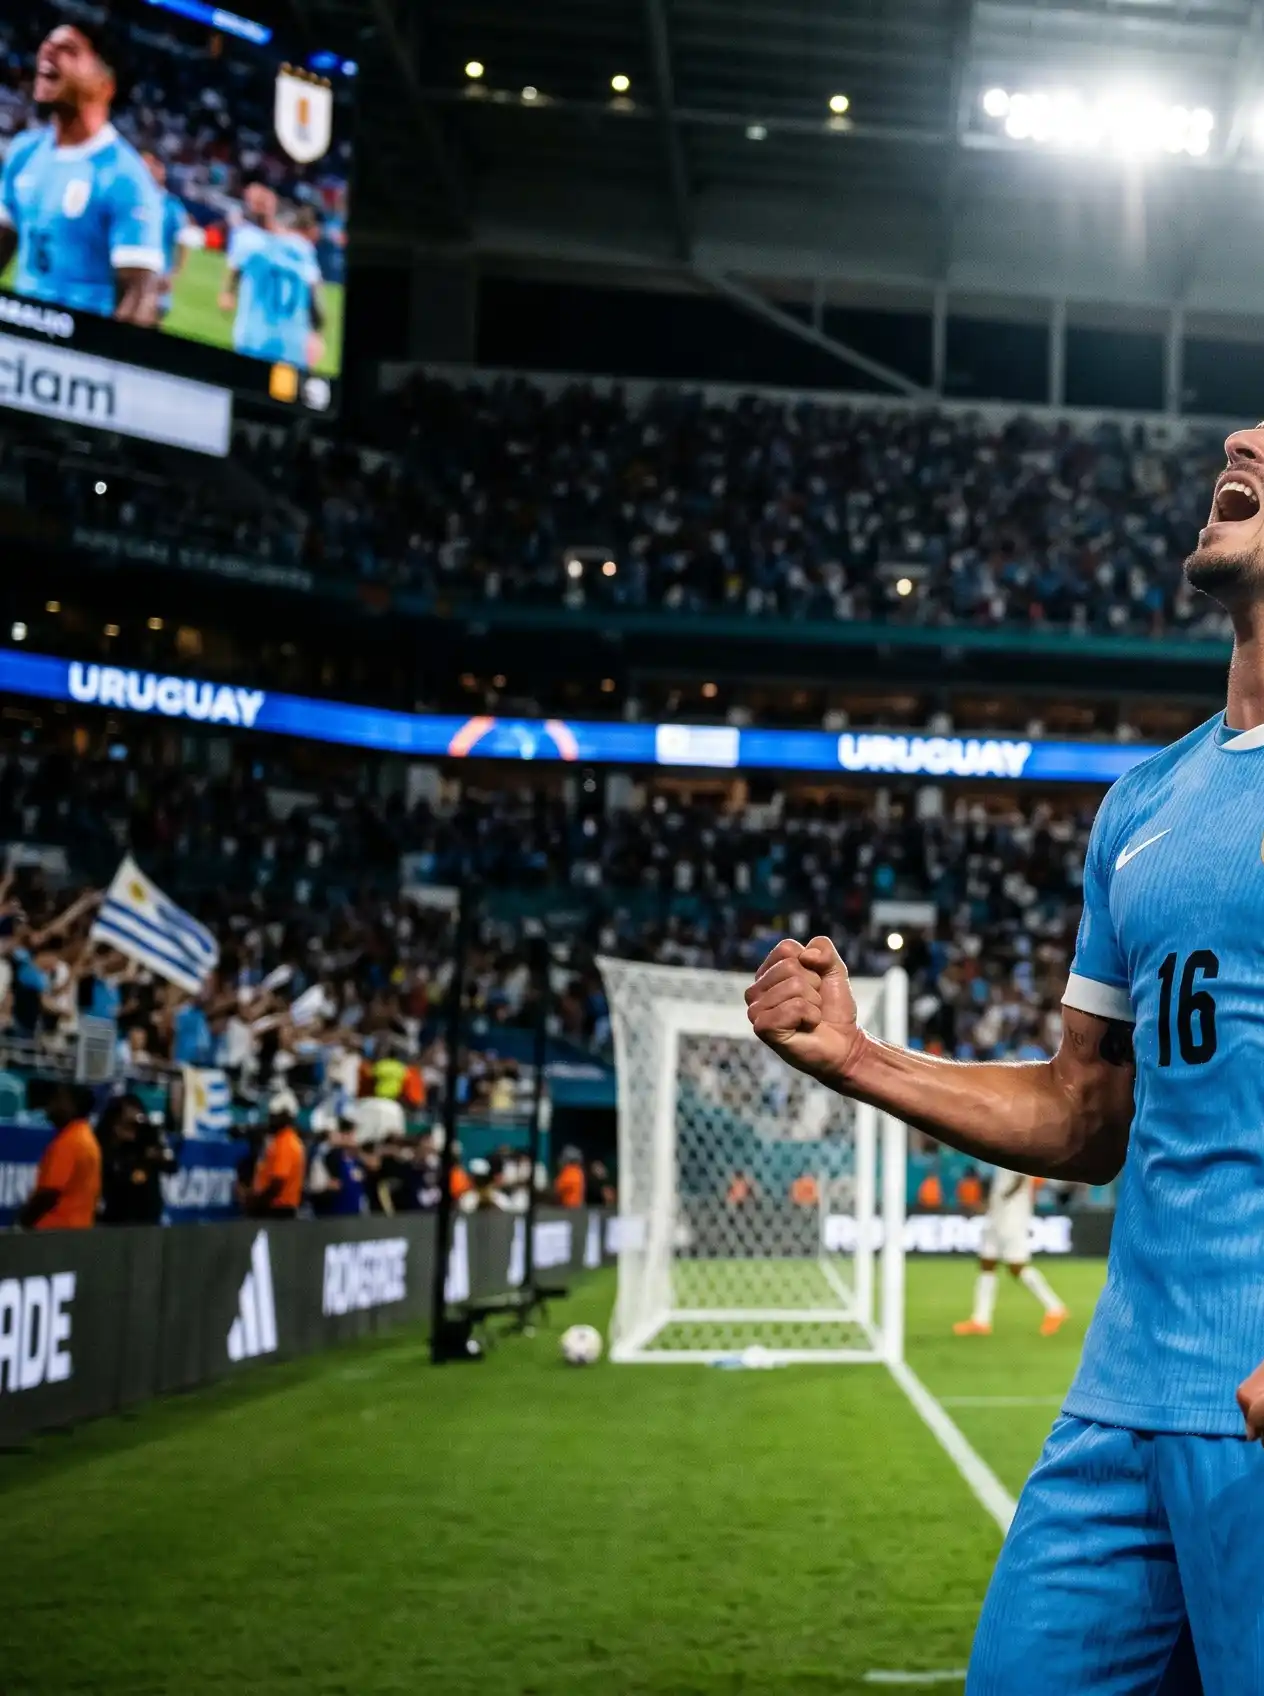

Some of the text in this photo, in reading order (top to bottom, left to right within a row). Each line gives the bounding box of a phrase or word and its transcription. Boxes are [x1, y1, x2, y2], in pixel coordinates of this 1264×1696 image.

[69, 661, 265, 727] URUGUAY
[838, 733, 1032, 778] URUGUAY
[1156, 949, 1220, 1067] 16
